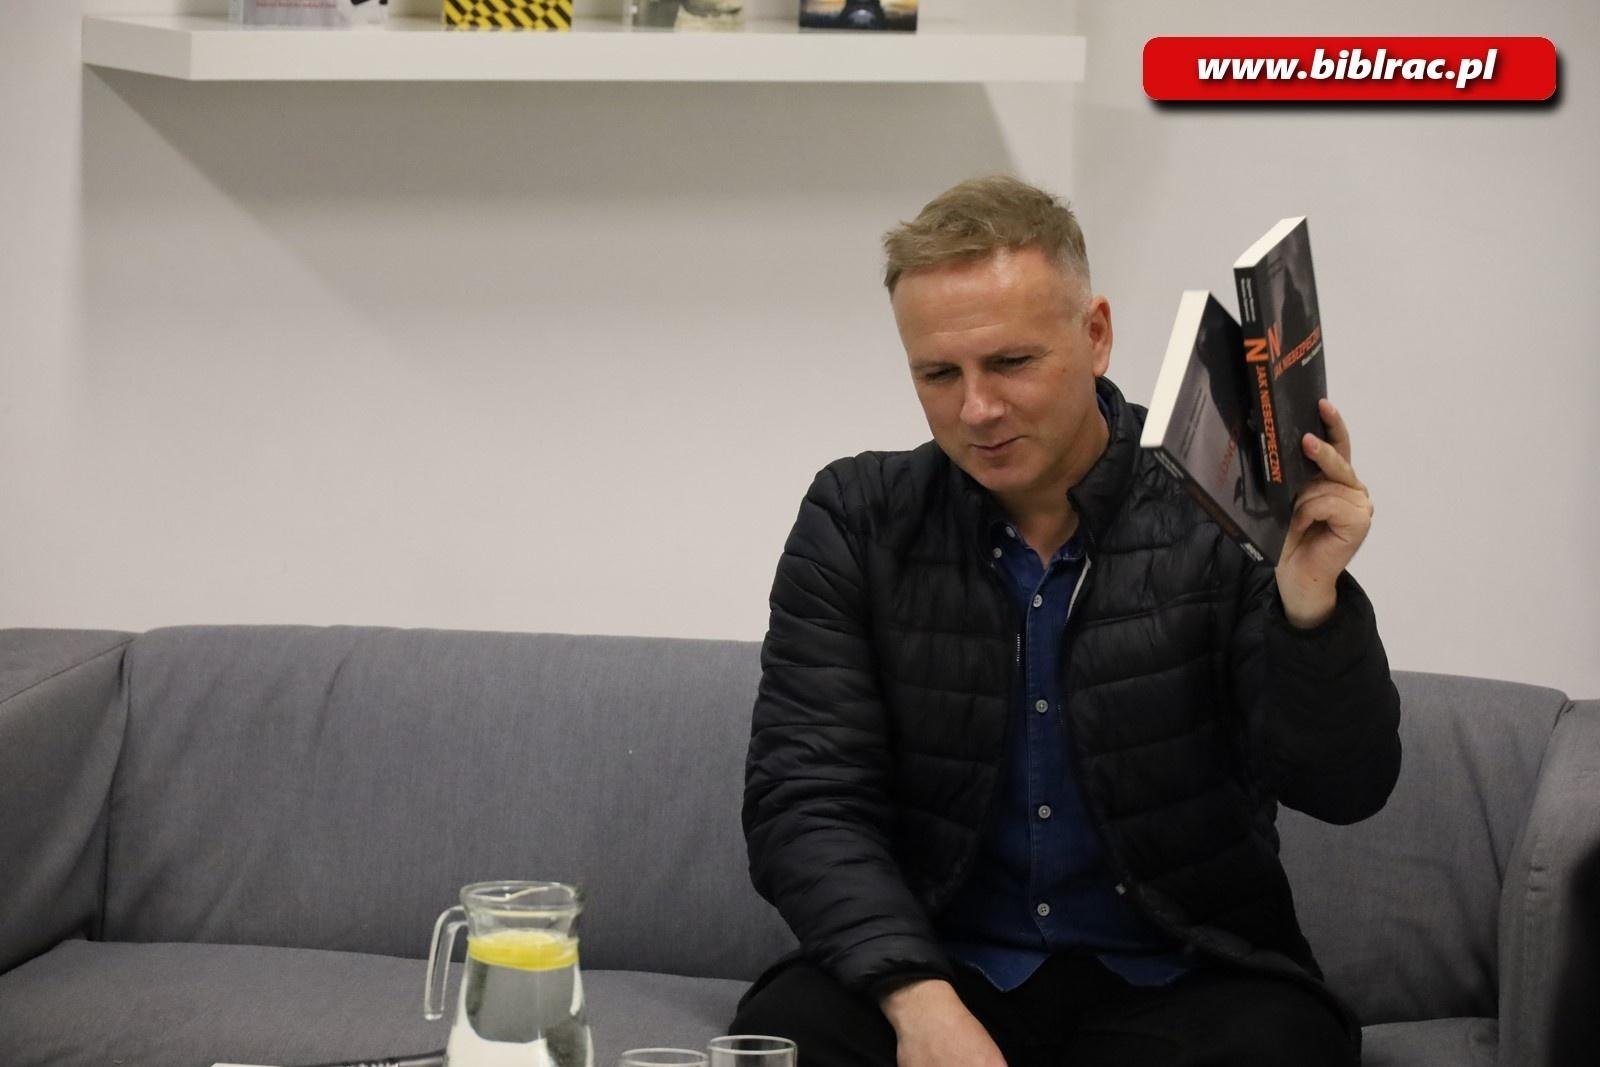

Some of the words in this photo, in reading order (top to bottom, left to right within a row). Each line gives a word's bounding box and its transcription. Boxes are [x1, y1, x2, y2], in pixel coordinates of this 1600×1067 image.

[1243, 338, 1270, 363] N
[1256, 365, 1268, 389] JAK
[1260, 390, 1282, 484] NIEBEZPIECZNY
